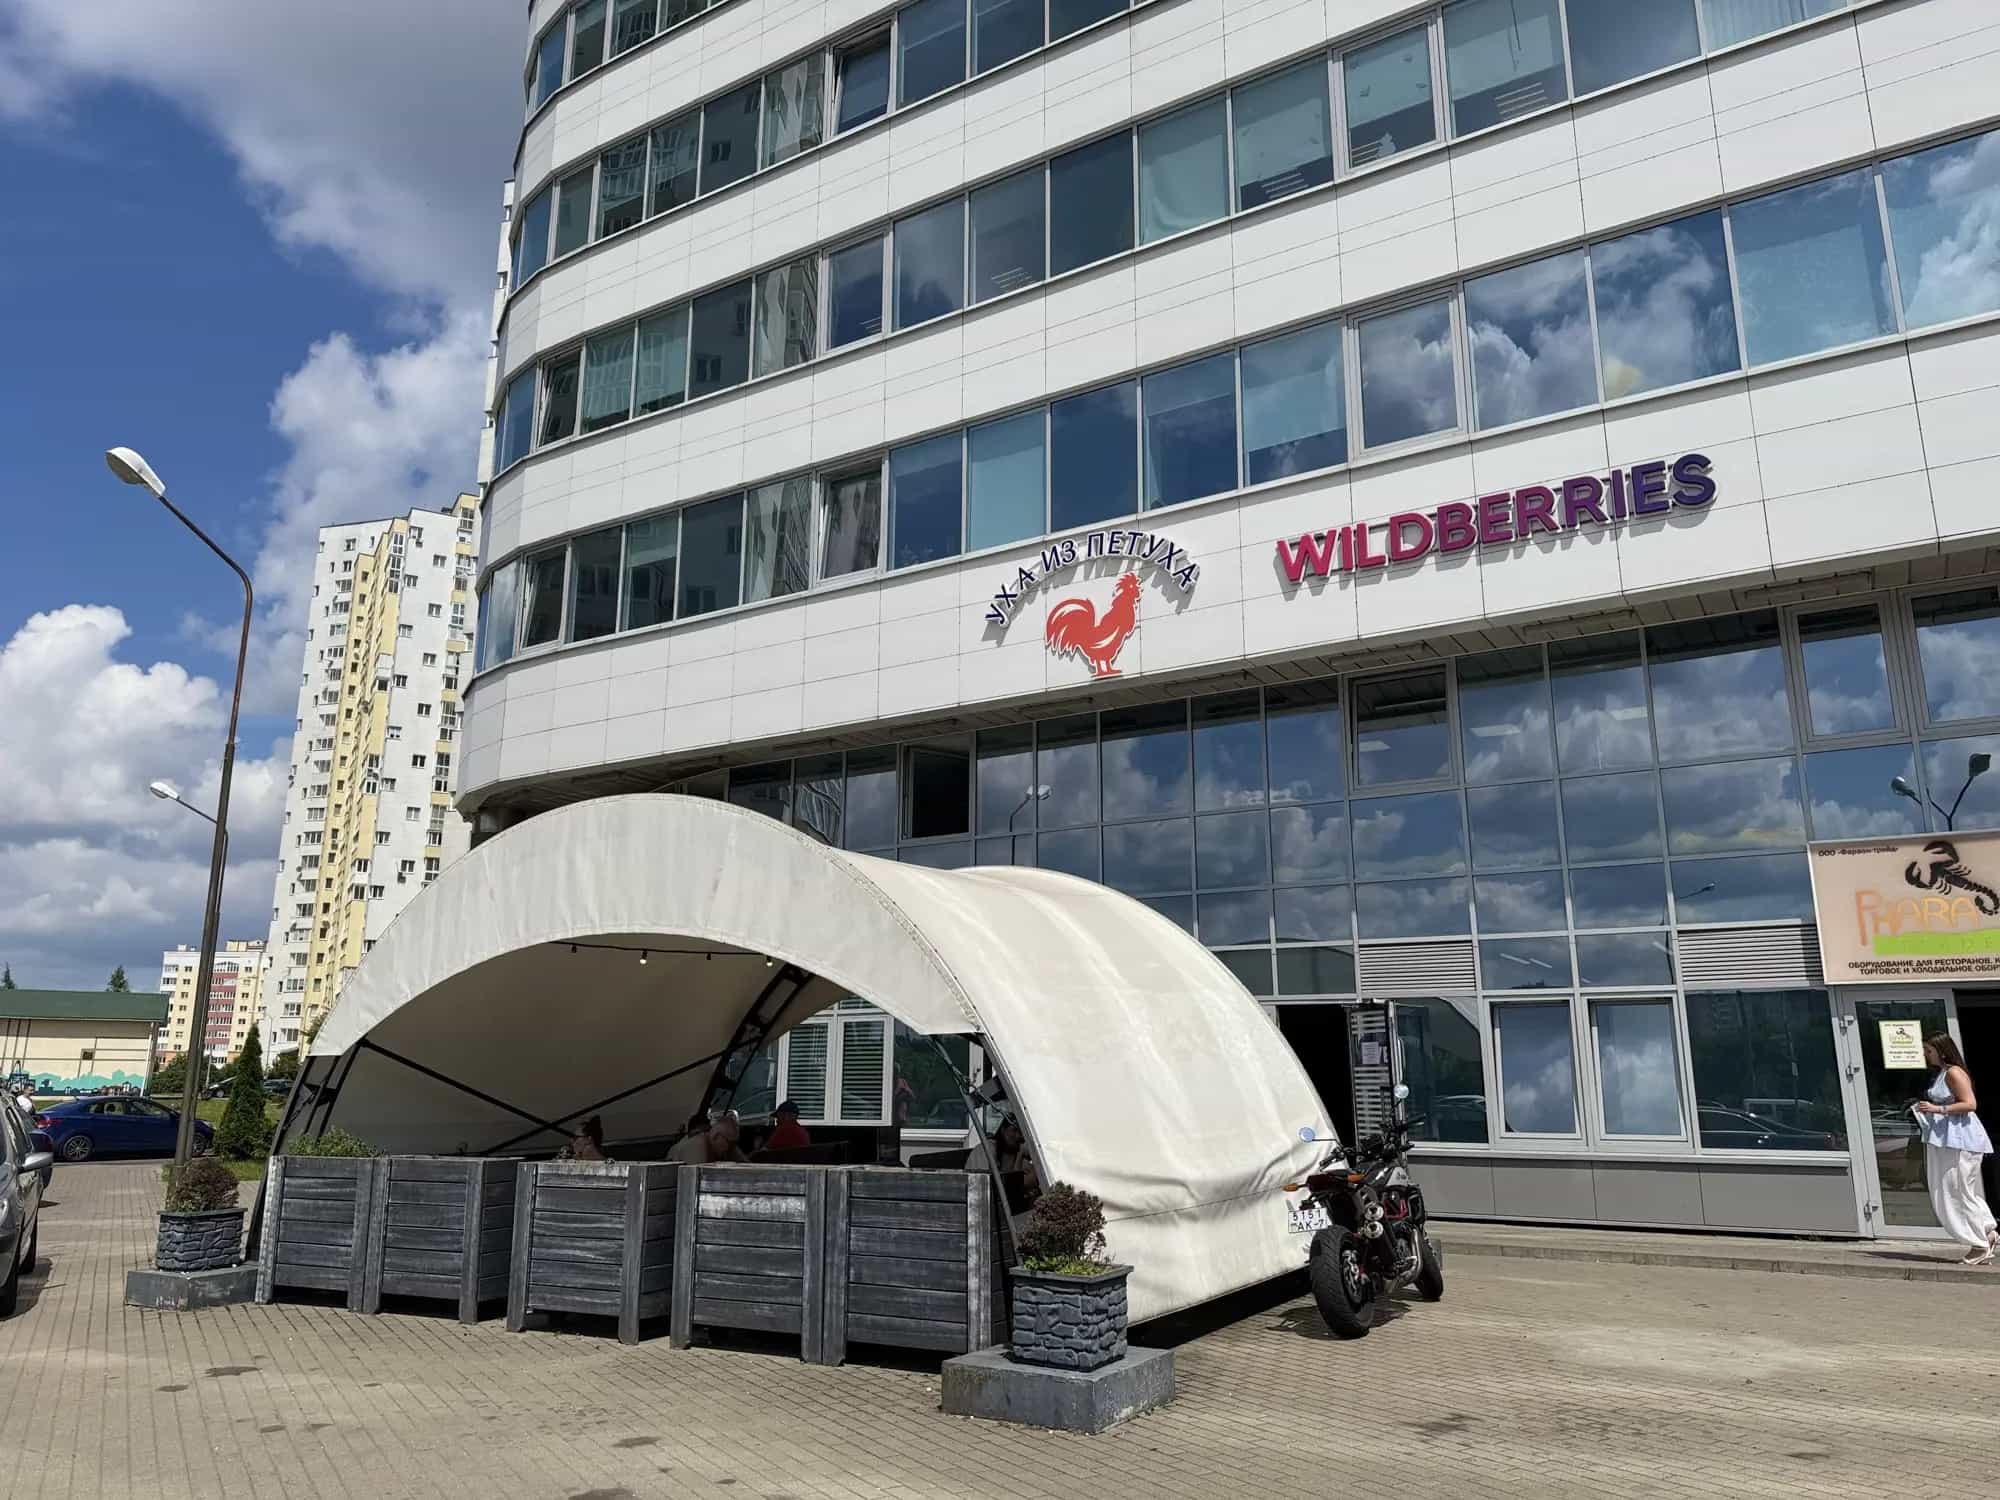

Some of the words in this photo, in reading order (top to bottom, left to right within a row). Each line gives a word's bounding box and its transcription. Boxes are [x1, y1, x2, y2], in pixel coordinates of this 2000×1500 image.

[1276, 453, 1717, 583] WILDBERRIES
[984, 565, 1036, 625] УХА
[1040, 539, 1076, 572] ИЗ
[1086, 530, 1198, 588] ПЕТУХА
[1818, 849, 1836, 857] ООО
[1848, 960, 1914, 970] ОБОРУДОВАНИЕ
[1916, 959, 1932, 967] ДЛЯ
[1860, 966, 1901, 975] ТОРГОВОЕ
[1911, 964, 1972, 974] ХОЛОДИЛЬНОЕ
